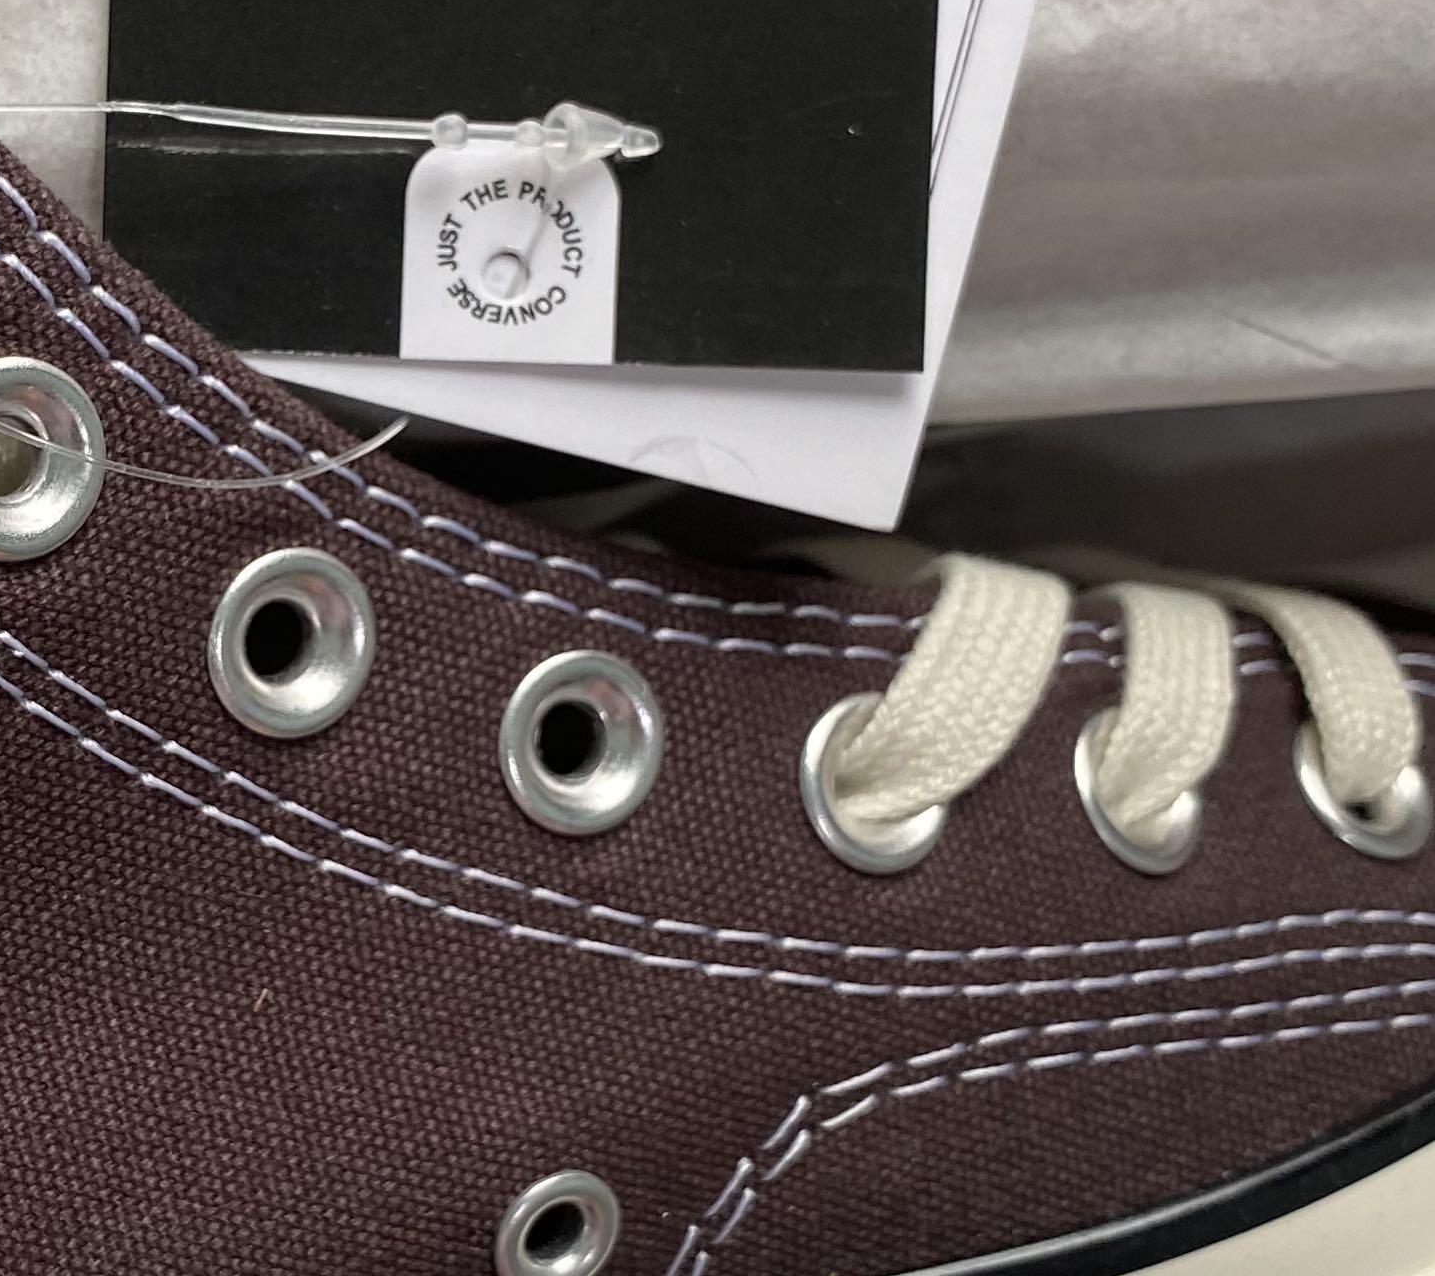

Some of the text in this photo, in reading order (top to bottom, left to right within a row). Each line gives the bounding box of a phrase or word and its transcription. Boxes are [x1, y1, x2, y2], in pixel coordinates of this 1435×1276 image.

[436, 213, 463, 271] JUST
[460, 179, 508, 212] THE
[447, 277, 566, 325] CONVERSE
